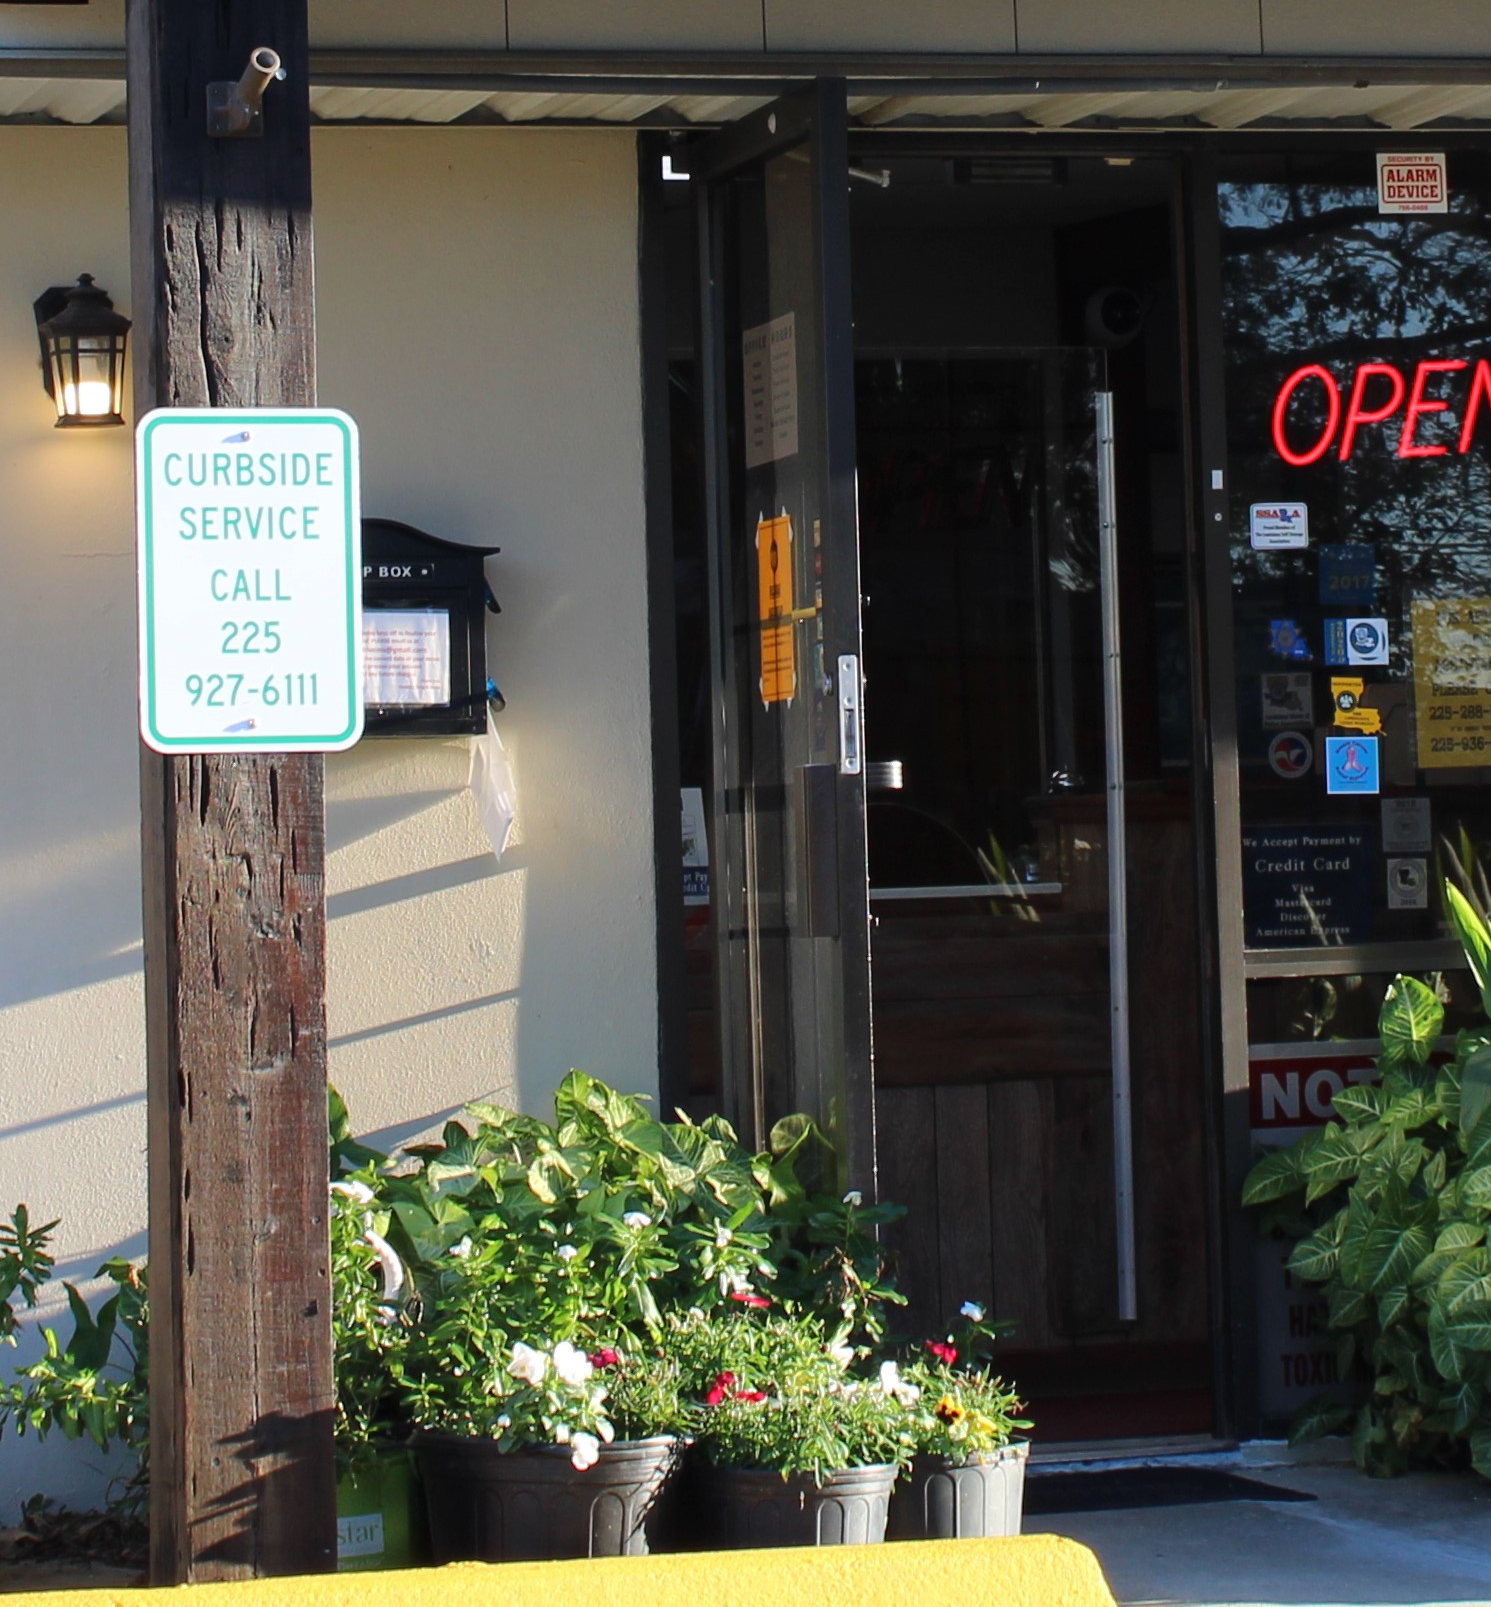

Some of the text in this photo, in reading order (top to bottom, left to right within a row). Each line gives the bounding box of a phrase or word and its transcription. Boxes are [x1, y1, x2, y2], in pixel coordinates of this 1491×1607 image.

[1387, 168, 1437, 182] ALARM
[1387, 185, 1439, 198] DEVICE
[164, 452, 333, 488] CURBSIDE
[179, 506, 320, 541] SERVICE
[378, 566, 412, 578] BOX
[211, 569, 292, 602] CALL
[221, 620, 281, 654] 225
[185, 673, 318, 707] 927-6111
[1242, 835, 1362, 849] We Accept Payment by
[1255, 857, 1351, 873] Credit Card
[1291, 883, 1315, 893] Visa
[1256, 926, 1307, 937] American
